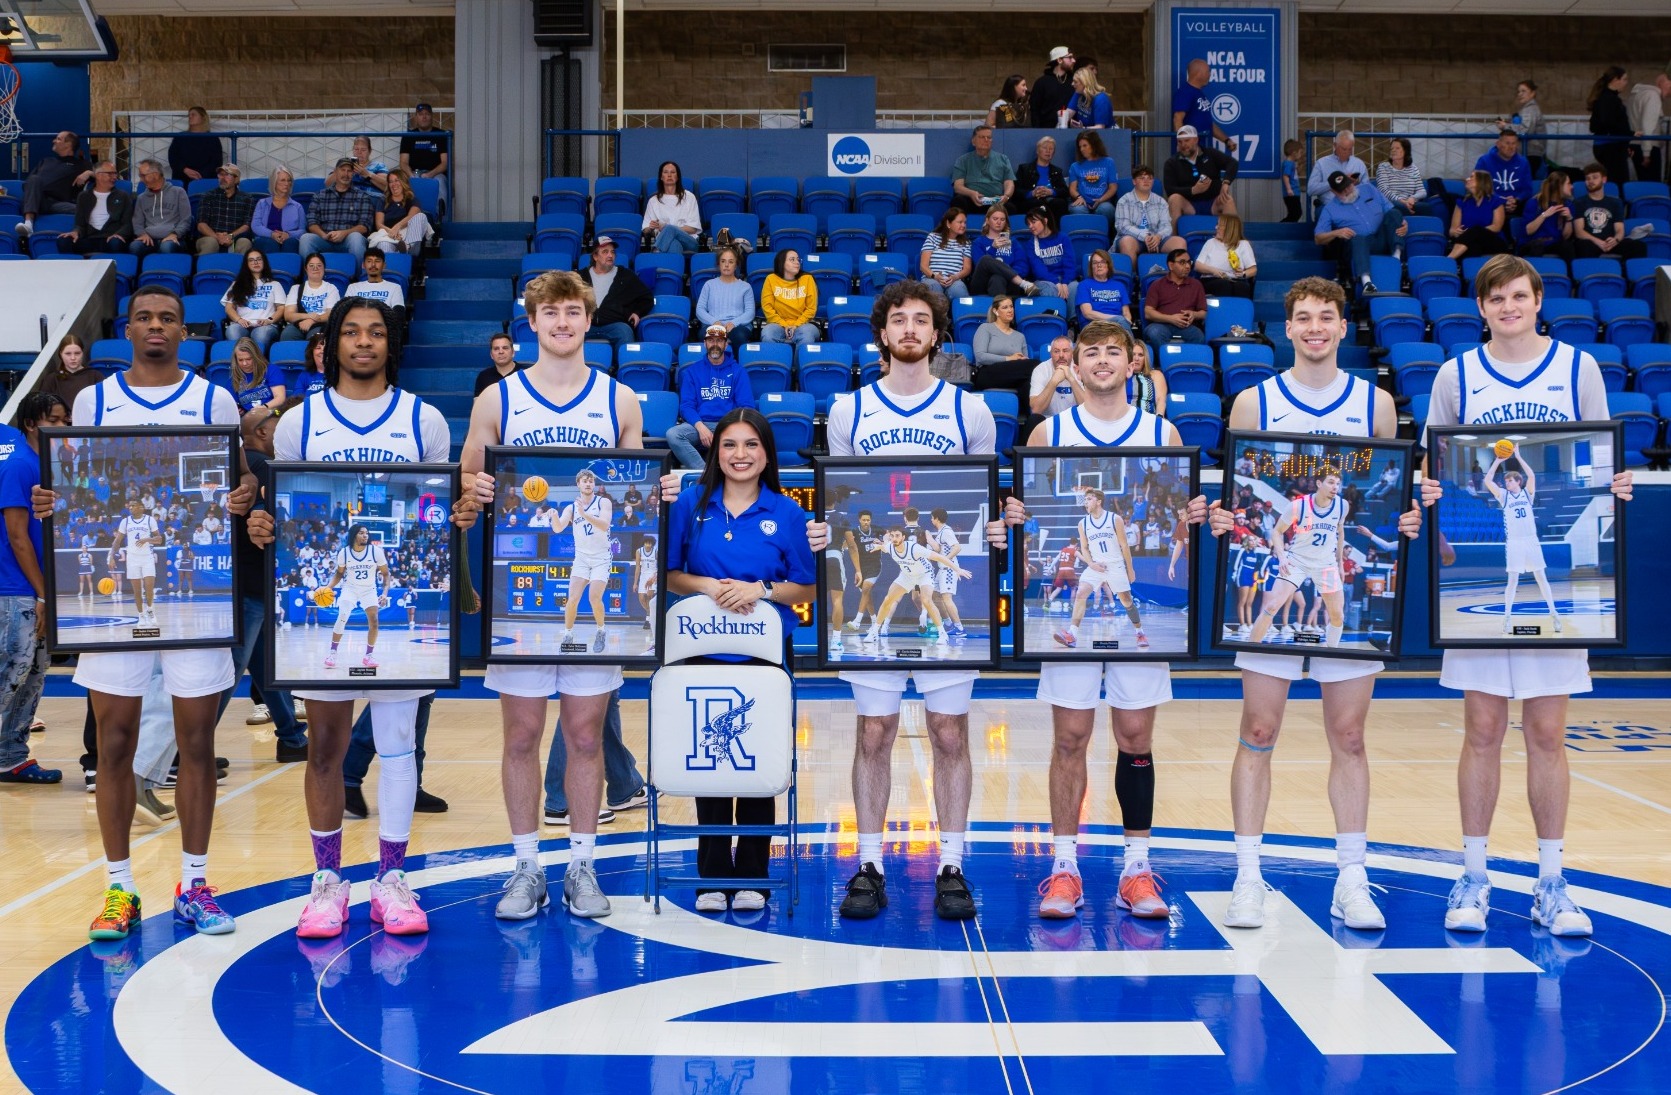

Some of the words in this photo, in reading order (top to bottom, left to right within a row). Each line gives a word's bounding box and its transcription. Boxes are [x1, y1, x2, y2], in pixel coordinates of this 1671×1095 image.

[1186, 22, 1266, 33] VOLLEYBALL
[1207, 51, 1246, 66] NCAA
[1229, 69, 1266, 83] FOUR
[836, 154, 869, 165] NCAA
[874, 154, 914, 165] Division
[302, 293, 328, 301] EFEND
[774, 286, 807, 299] PINK
[859, 428, 956, 455] ROCKHURST
[322, 447, 411, 462] CKHUR
[1514, 507, 1527, 518] 30
[583, 523, 593, 536] 12
[1312, 533, 1327, 546] 21
[1099, 541, 1108, 553] 11
[1059, 551, 1069, 562] 25
[193, 556, 213, 570] THE
[510, 565, 544, 573] ROCKHURST
[354, 570, 368, 579] 23
[517, 577, 532, 588] 89
[676, 615, 767, 640] Rockhurst
